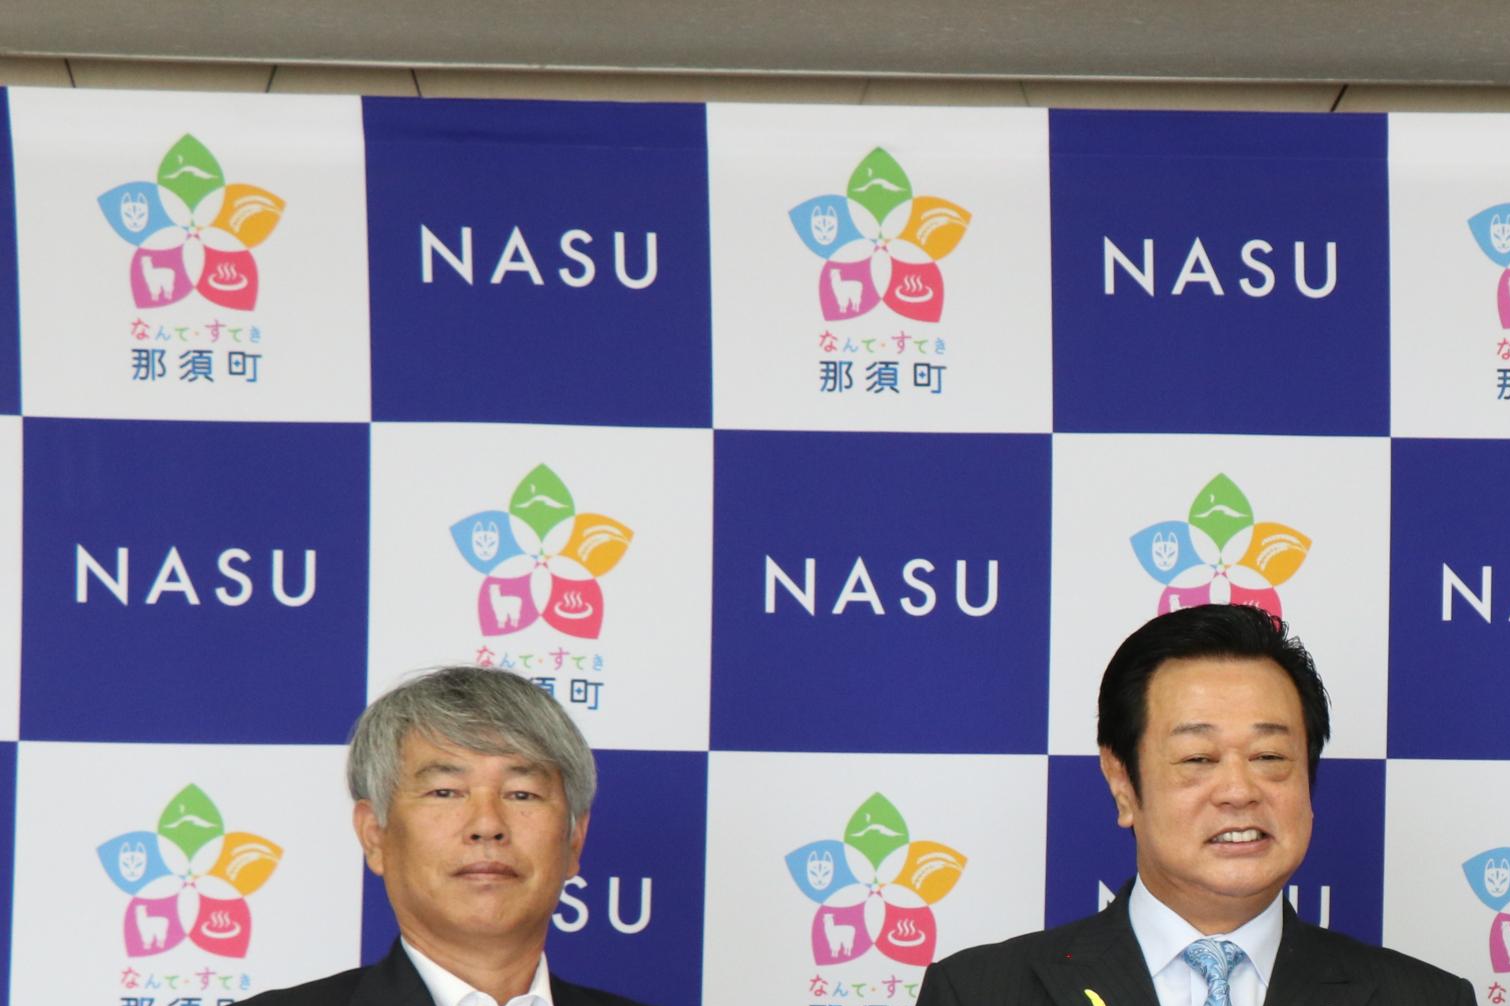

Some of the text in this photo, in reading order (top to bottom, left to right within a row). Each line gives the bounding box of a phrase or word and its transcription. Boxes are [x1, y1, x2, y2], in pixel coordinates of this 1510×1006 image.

[420, 224, 659, 290] NASU
[1102, 236, 1337, 299] NASU
[131, 348, 263, 383] 那須町
[819, 360, 947, 395] 那須町
[75, 542, 317, 609] NASU
[764, 555, 1000, 617] NASU
[552, 875, 652, 934] SU
[809, 975, 918, 998] なんて・すて
